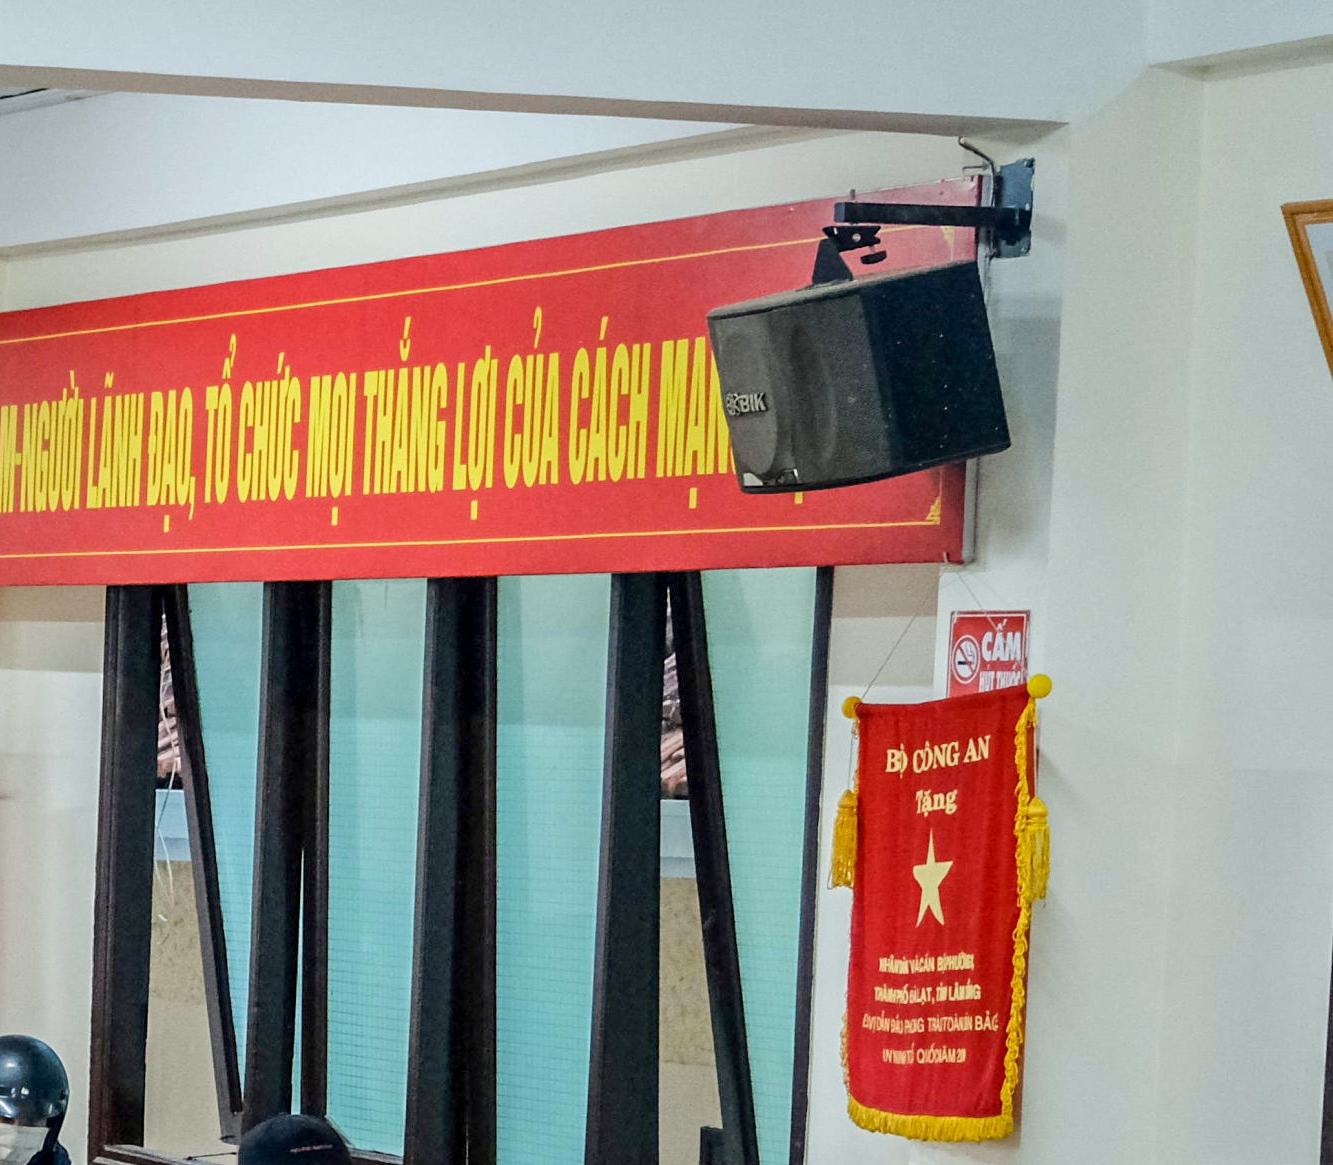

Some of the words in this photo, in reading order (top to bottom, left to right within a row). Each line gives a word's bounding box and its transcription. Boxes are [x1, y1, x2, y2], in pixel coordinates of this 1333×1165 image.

[86, 372, 144, 509] LÃNH
[146, 386, 196, 533] ĐẠO,
[204, 333, 236, 505] TỔ
[237, 352, 301, 503] CHỨC
[305, 371, 356, 527] MỌI
[363, 316, 448, 496] THẮNG
[452, 344, 498, 521] LỢI
[503, 306, 559, 490] CỦA
[568, 316, 652, 485] CÁCH
[656, 337, 737, 509] MẠN
[981, 618, 1021, 662] CẤM
[885, 743, 909, 779] BỘ
[912, 740, 961, 774] CÔNG
[963, 735, 991, 763] AN
[916, 789, 958, 817] Tặng
